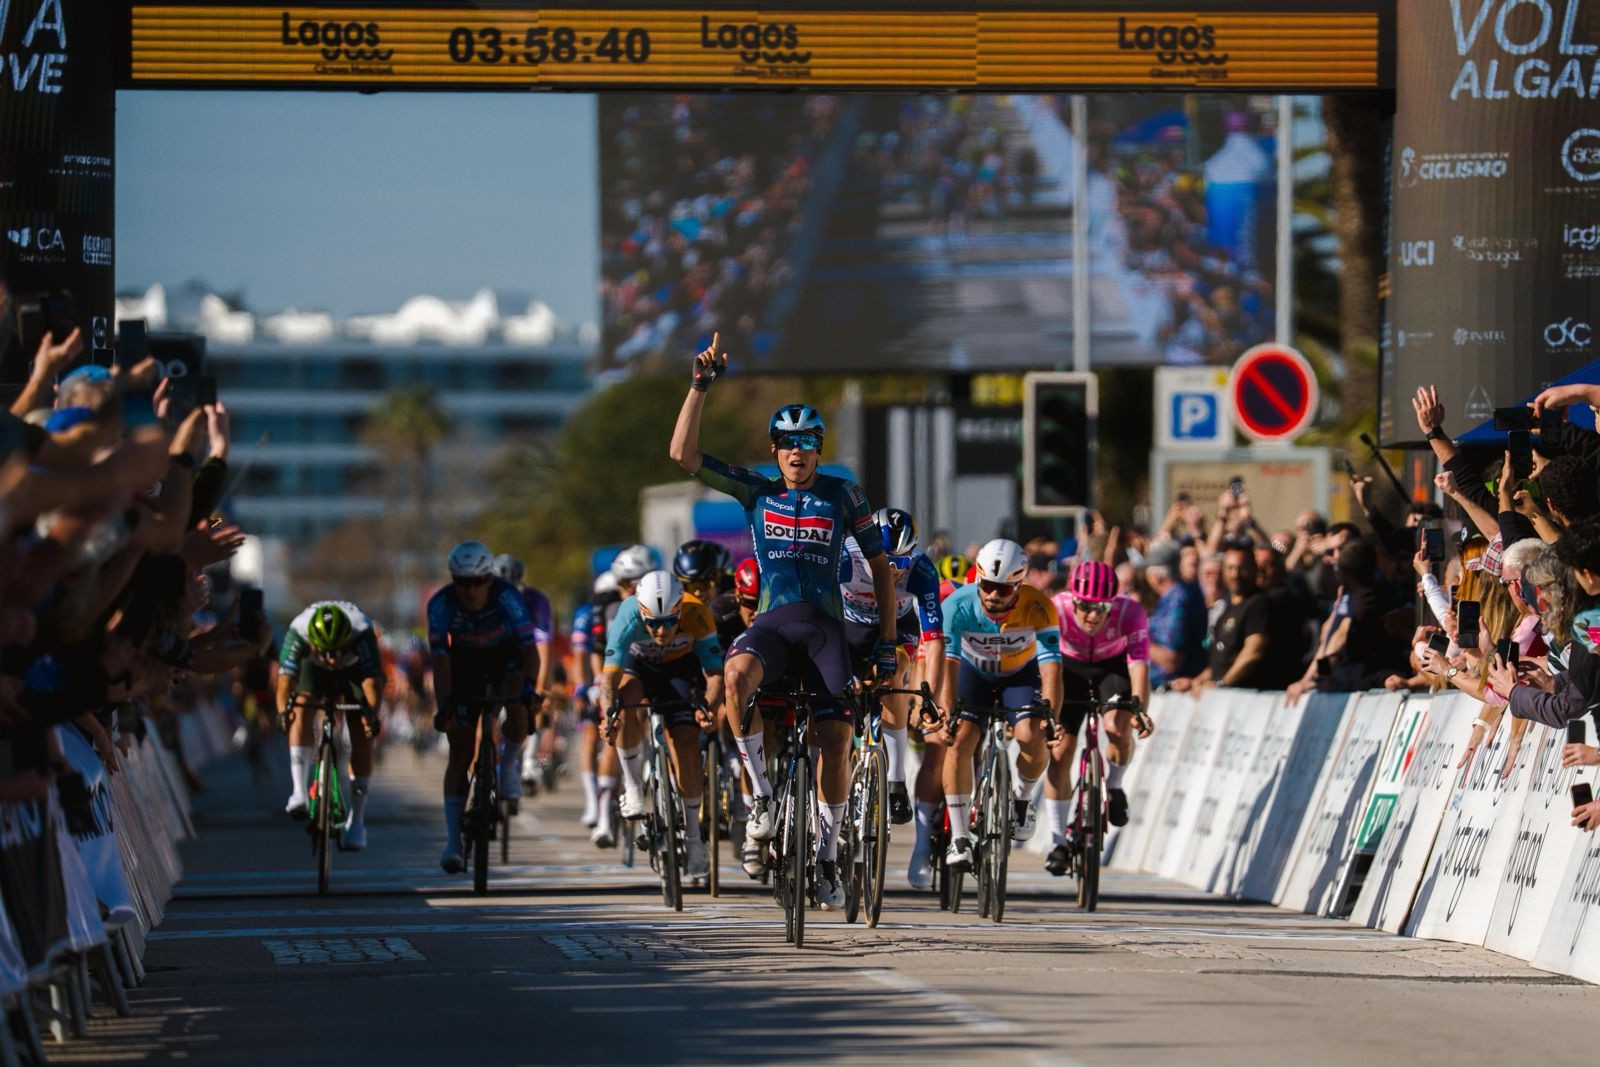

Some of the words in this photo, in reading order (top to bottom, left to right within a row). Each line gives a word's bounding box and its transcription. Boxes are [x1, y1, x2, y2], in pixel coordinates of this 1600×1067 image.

[282, 12, 380, 60] Lagos
[449, 26, 650, 64] 03:58:40
[701, 15, 799, 63] Lagos
[1118, 16, 1217, 64] Lagos
[0, 53, 66, 92] VE
[1419, 159, 1508, 180] CICLISMO
[1400, 240, 1434, 266] UCI
[1180, 396, 1209, 435] P
[765, 497, 796, 512] Ekopak
[765, 524, 830, 543] SOUDAL
[924, 592, 939, 624] BOSS
